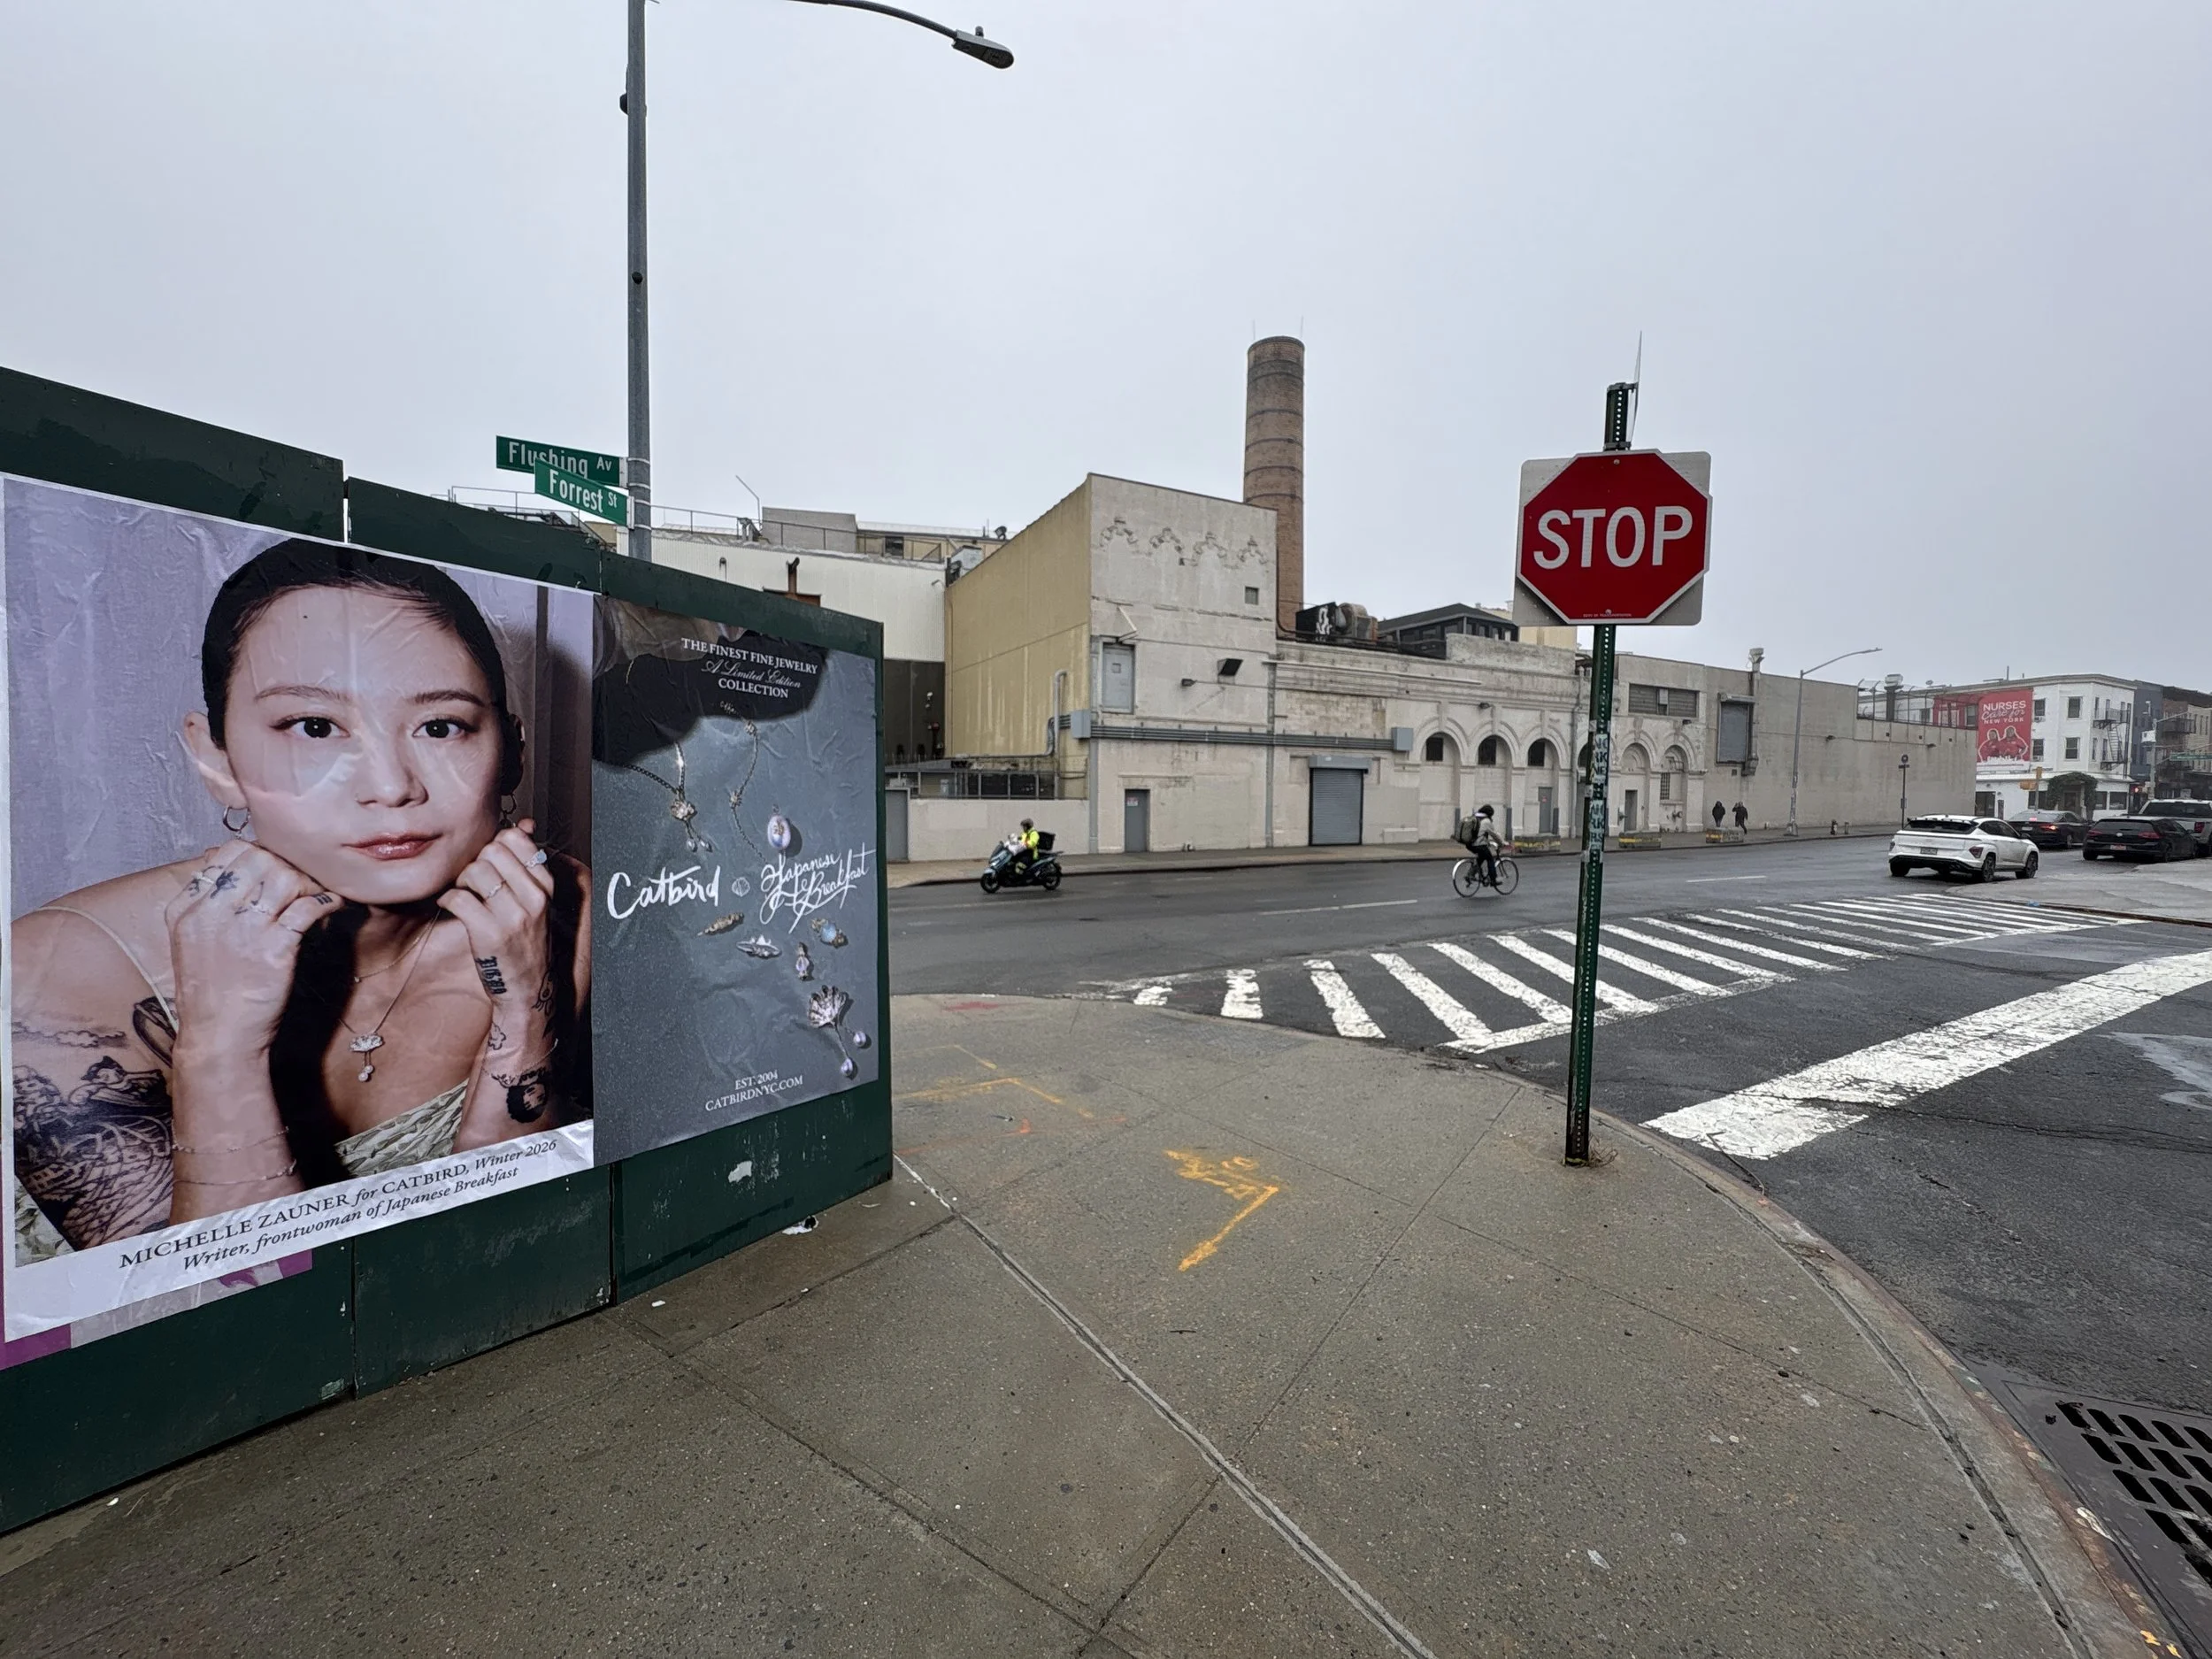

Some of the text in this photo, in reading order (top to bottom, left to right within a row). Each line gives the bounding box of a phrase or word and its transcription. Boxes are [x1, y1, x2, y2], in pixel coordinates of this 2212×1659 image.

[509, 442, 612, 479] Flushing Av
[549, 469, 618, 513] Forrest St
[1533, 506, 1693, 569] STOP
[680, 637, 818, 674] THE FINEST FINE JEWELRY
[701, 659, 802, 688] A Limited Edition
[718, 678, 789, 699] COLLECTION
[1983, 700, 2026, 711] NURSES
[1981, 710, 2008, 721] Care
[607, 864, 721, 920] Catbird
[760, 853, 842, 925] Japanese
[790, 842, 876, 934] Breakfast
[705, 1074, 803, 1111] CATBIRDNYC.COM
[734, 1069, 779, 1090] EST. 2004
[119, 1139, 558, 1269] MICHELLE ZAUNER for CATBIRD, Winter 2026
[183, 1166, 519, 1271] Writer, frontwoman of Japanese Breakfast
